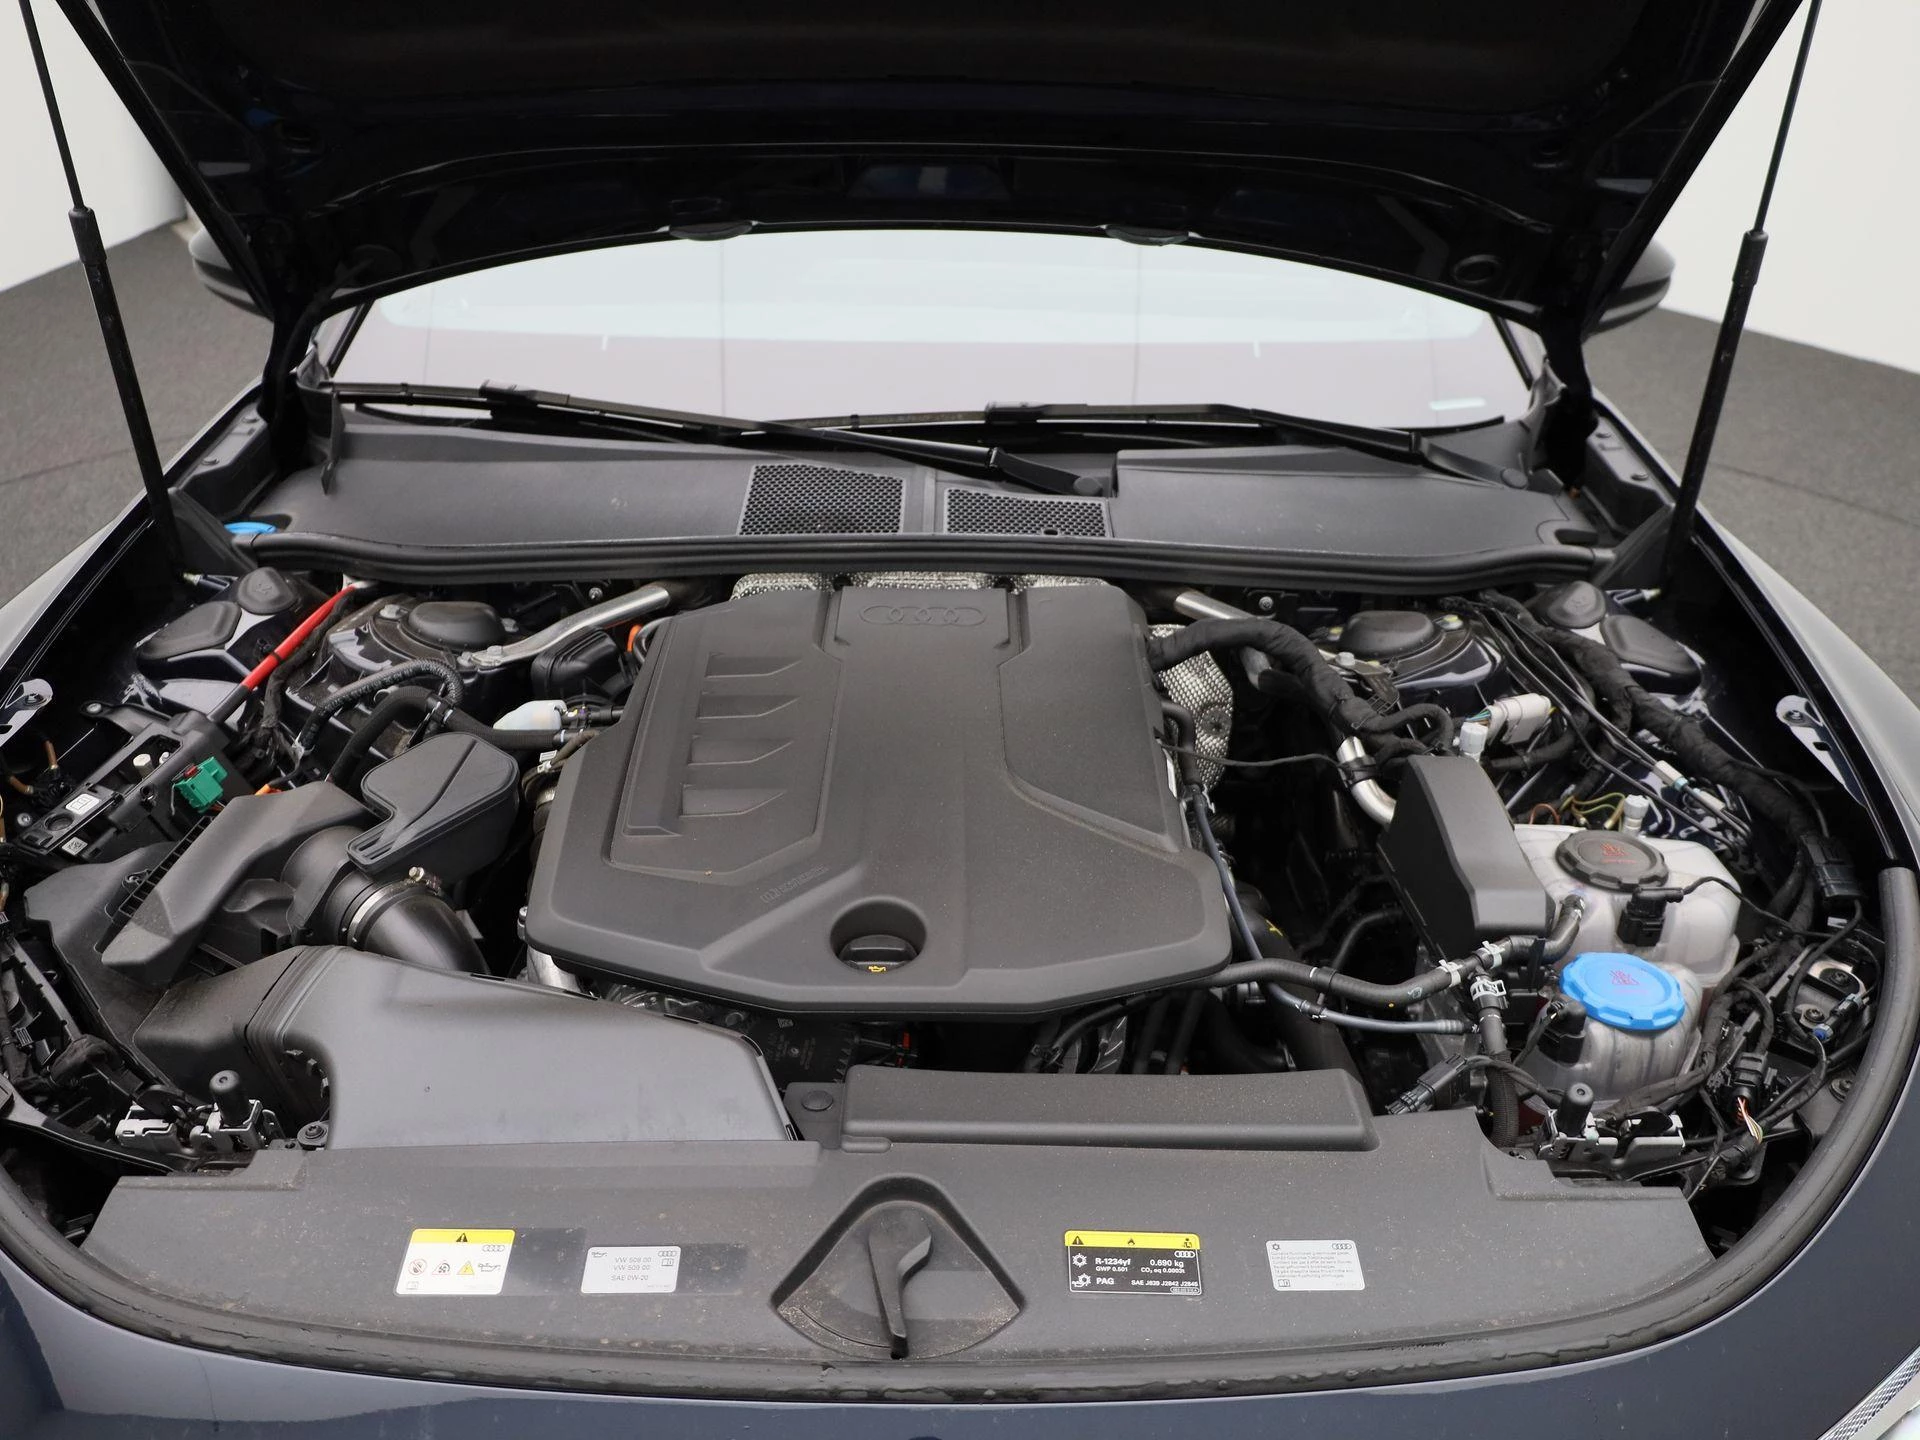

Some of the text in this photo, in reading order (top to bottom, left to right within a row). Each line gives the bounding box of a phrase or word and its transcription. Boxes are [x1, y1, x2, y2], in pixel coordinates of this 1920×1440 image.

[1095, 1257, 1131, 1266] R-1234yf
[1174, 1260, 1184, 1268] kg
[1096, 1277, 1115, 1285] PAG
